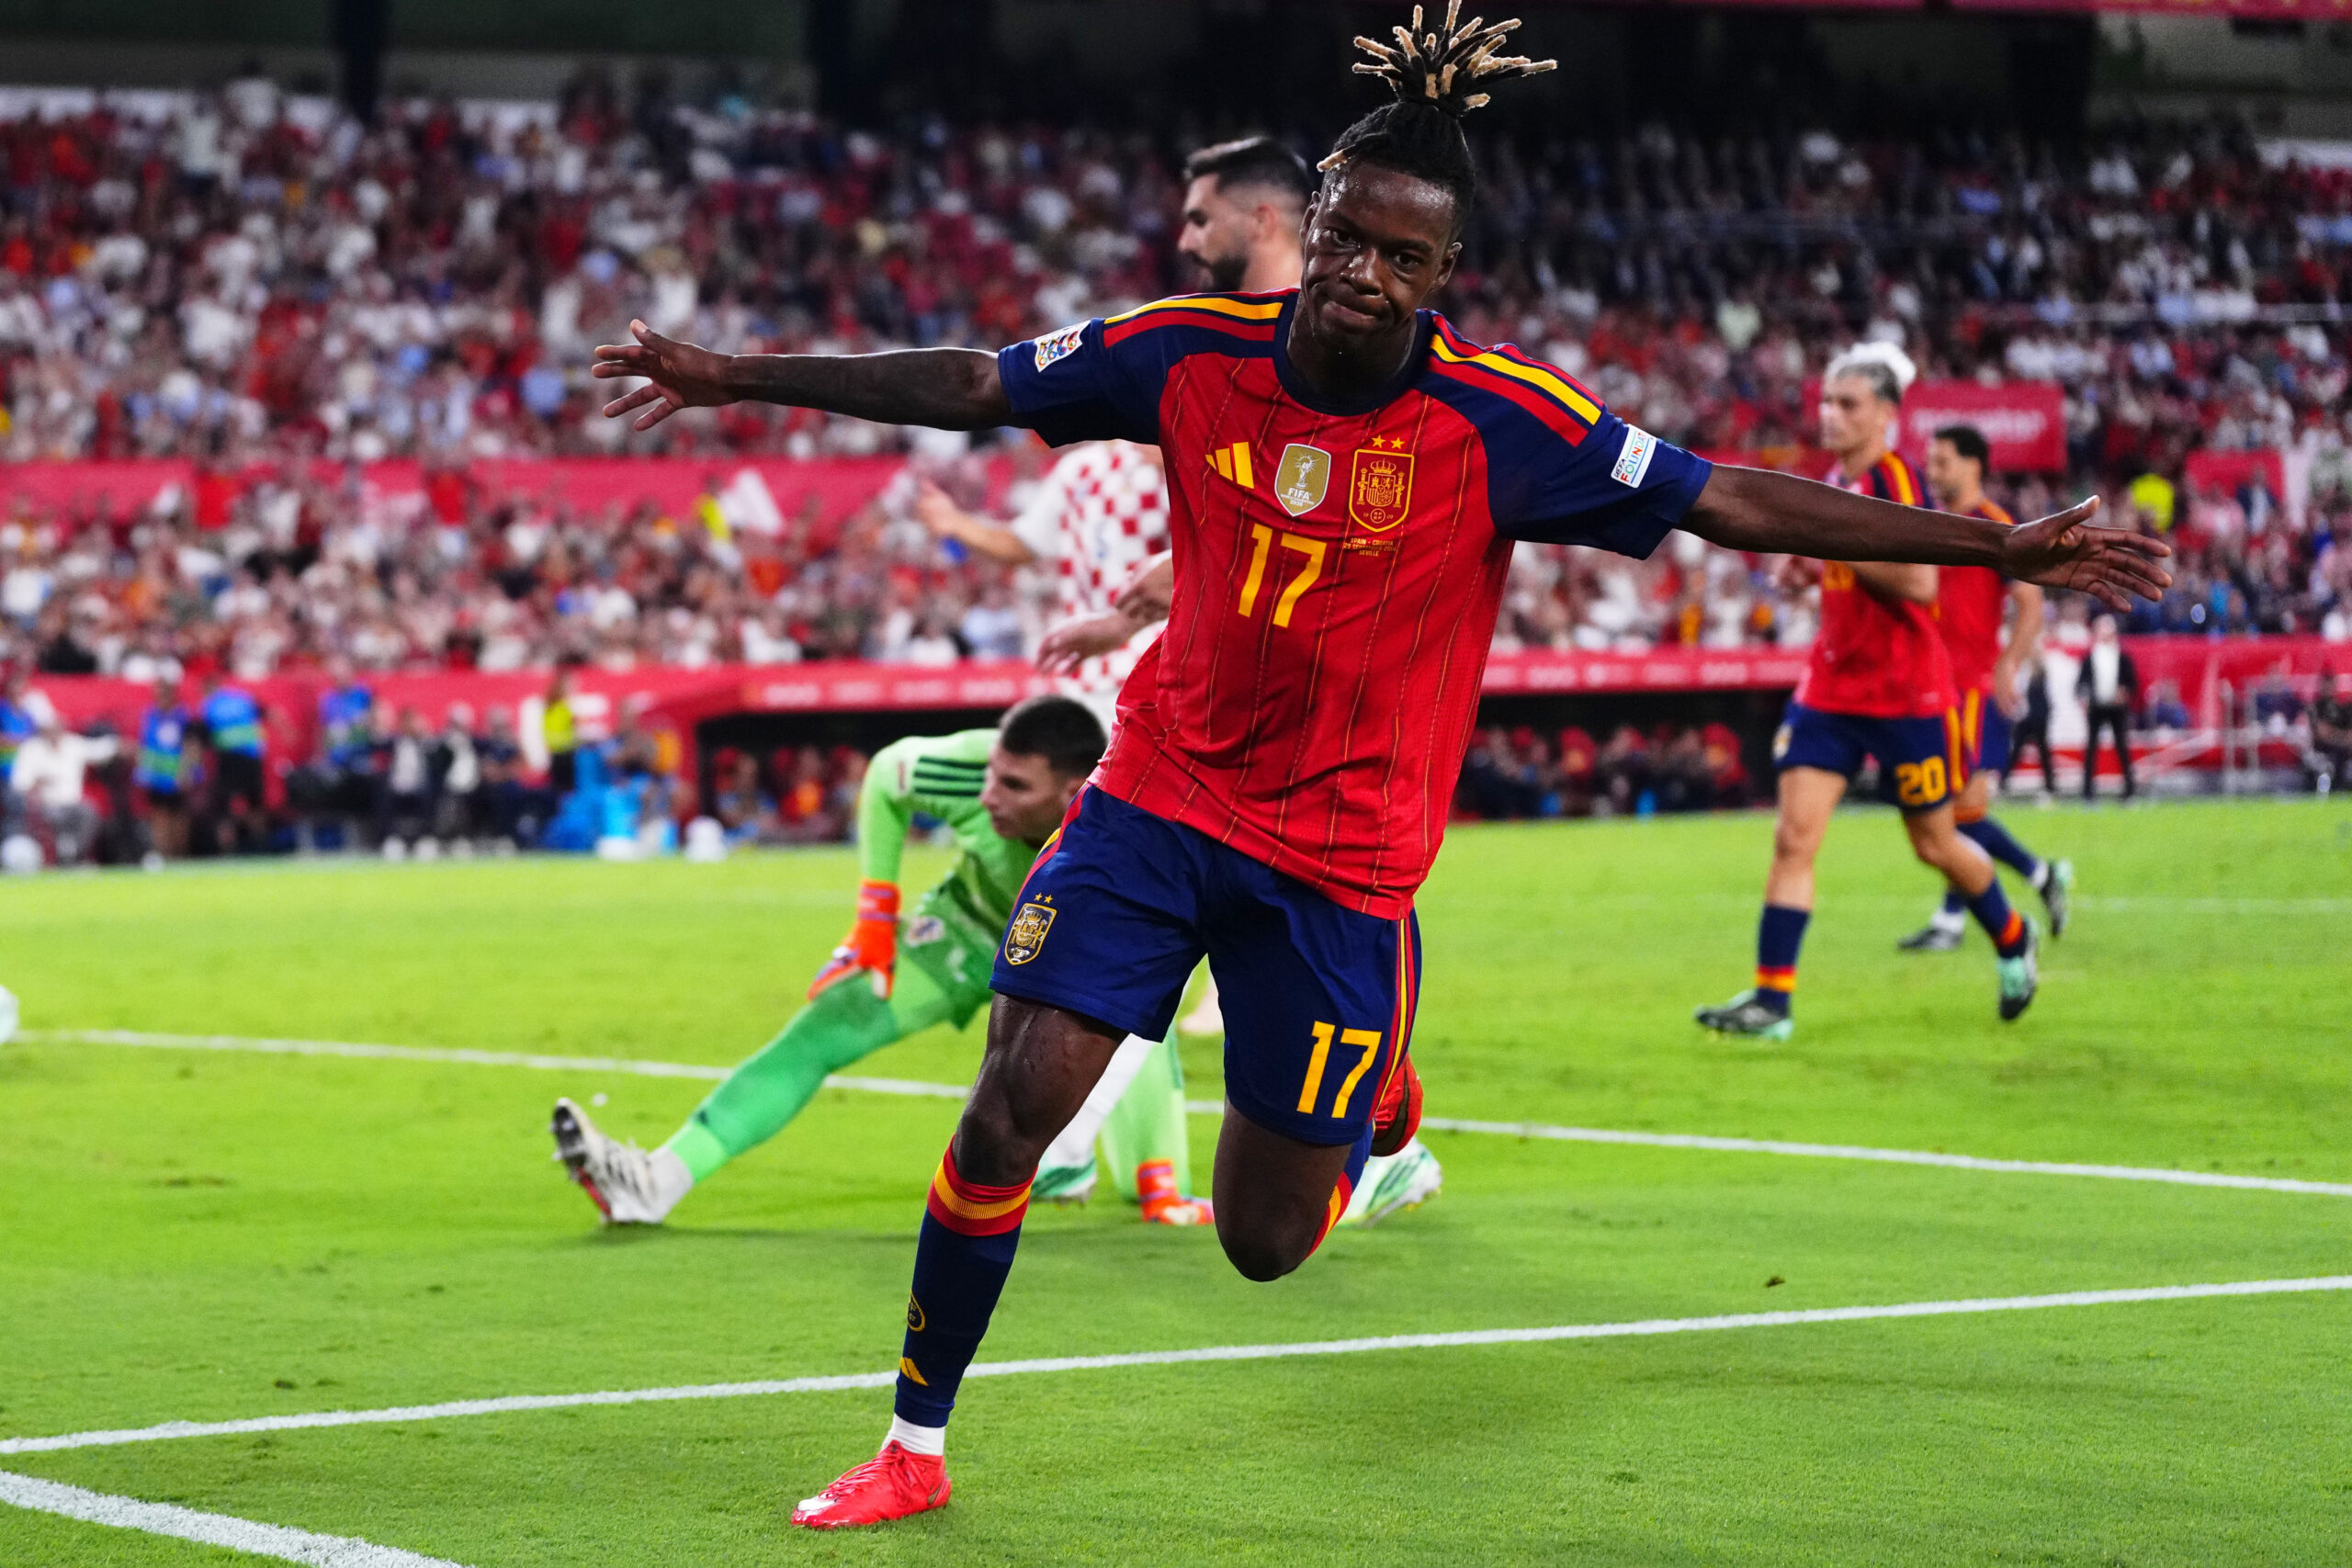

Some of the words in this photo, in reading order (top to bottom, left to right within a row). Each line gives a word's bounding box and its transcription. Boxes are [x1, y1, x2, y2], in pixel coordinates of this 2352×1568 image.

[1614, 458, 1627, 478] UEFA
[1288, 488, 1310, 500] FIFA
[1238, 523, 1328, 628] 17
[1895, 756, 1946, 806] 20
[1296, 1021, 1382, 1118] 17
